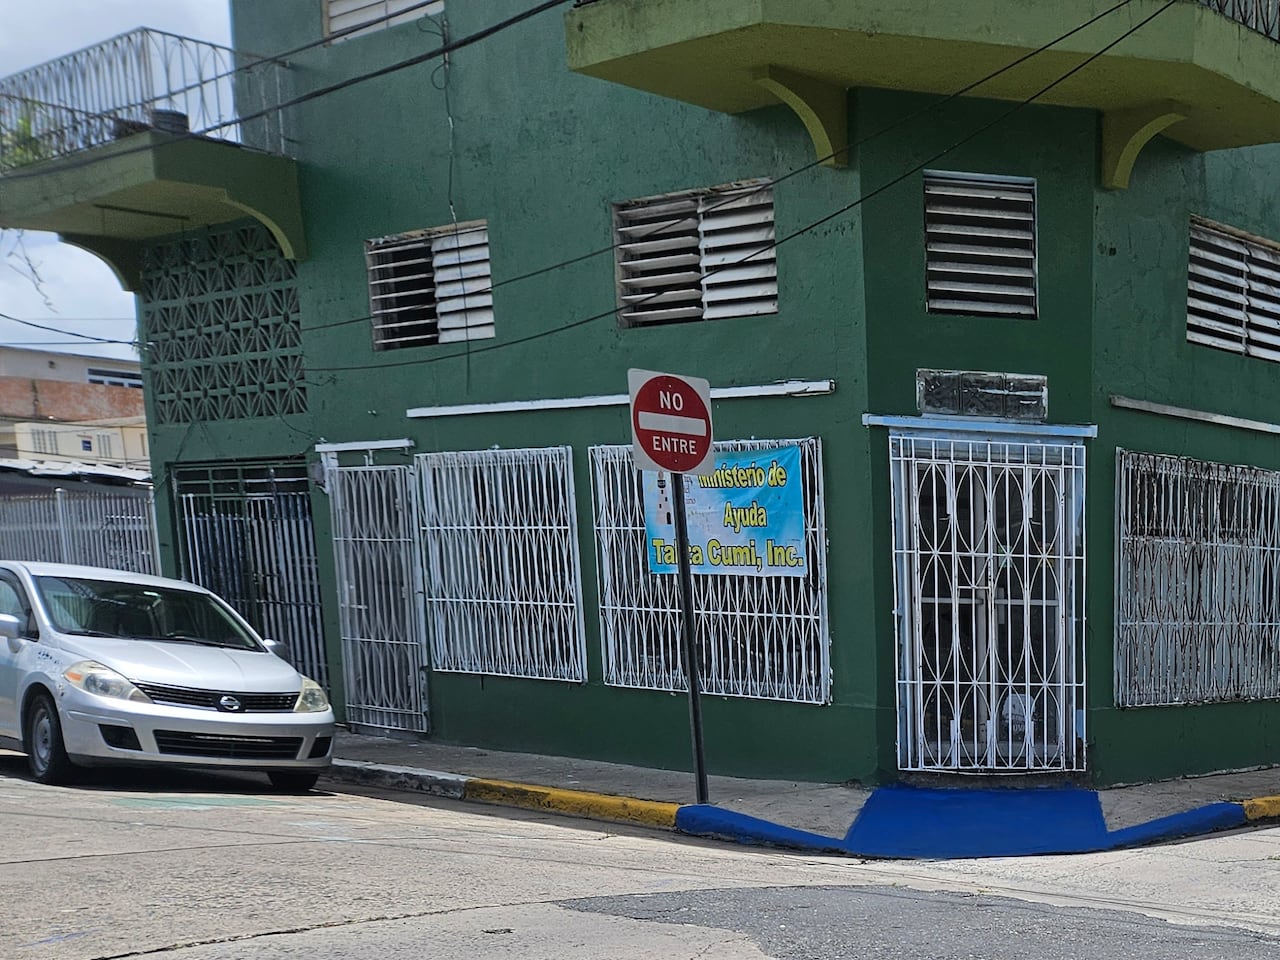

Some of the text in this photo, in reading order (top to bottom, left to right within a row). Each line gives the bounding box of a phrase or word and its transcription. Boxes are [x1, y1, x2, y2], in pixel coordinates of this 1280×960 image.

[660, 390, 684, 411] NO
[652, 436, 698, 455] ENTRE
[768, 460, 787, 488] de
[723, 500, 768, 534] Ayuda
[706, 538, 763, 572] Cumi,
[765, 539, 804, 568] Inc.
